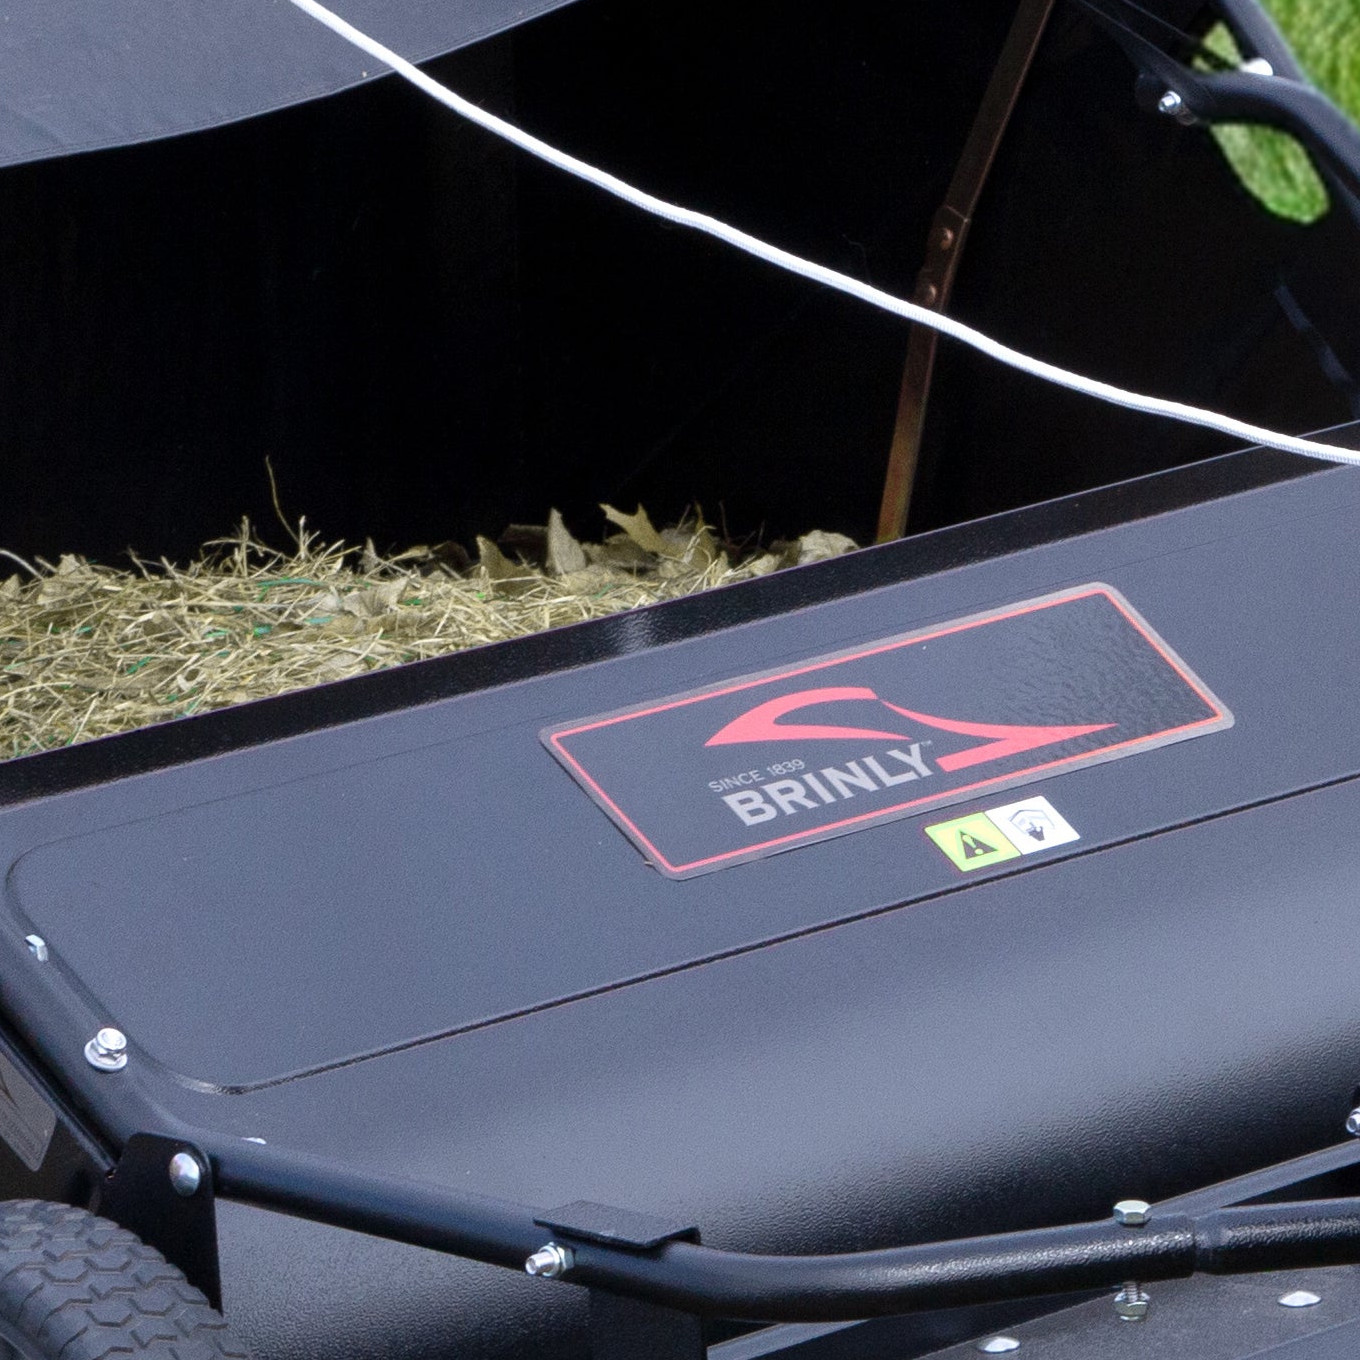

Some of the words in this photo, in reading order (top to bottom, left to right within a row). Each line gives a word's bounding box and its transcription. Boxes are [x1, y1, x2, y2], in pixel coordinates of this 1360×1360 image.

[708, 769, 766, 792] SINCE
[766, 758, 806, 777] 1839
[721, 743, 934, 826] BRINLY
